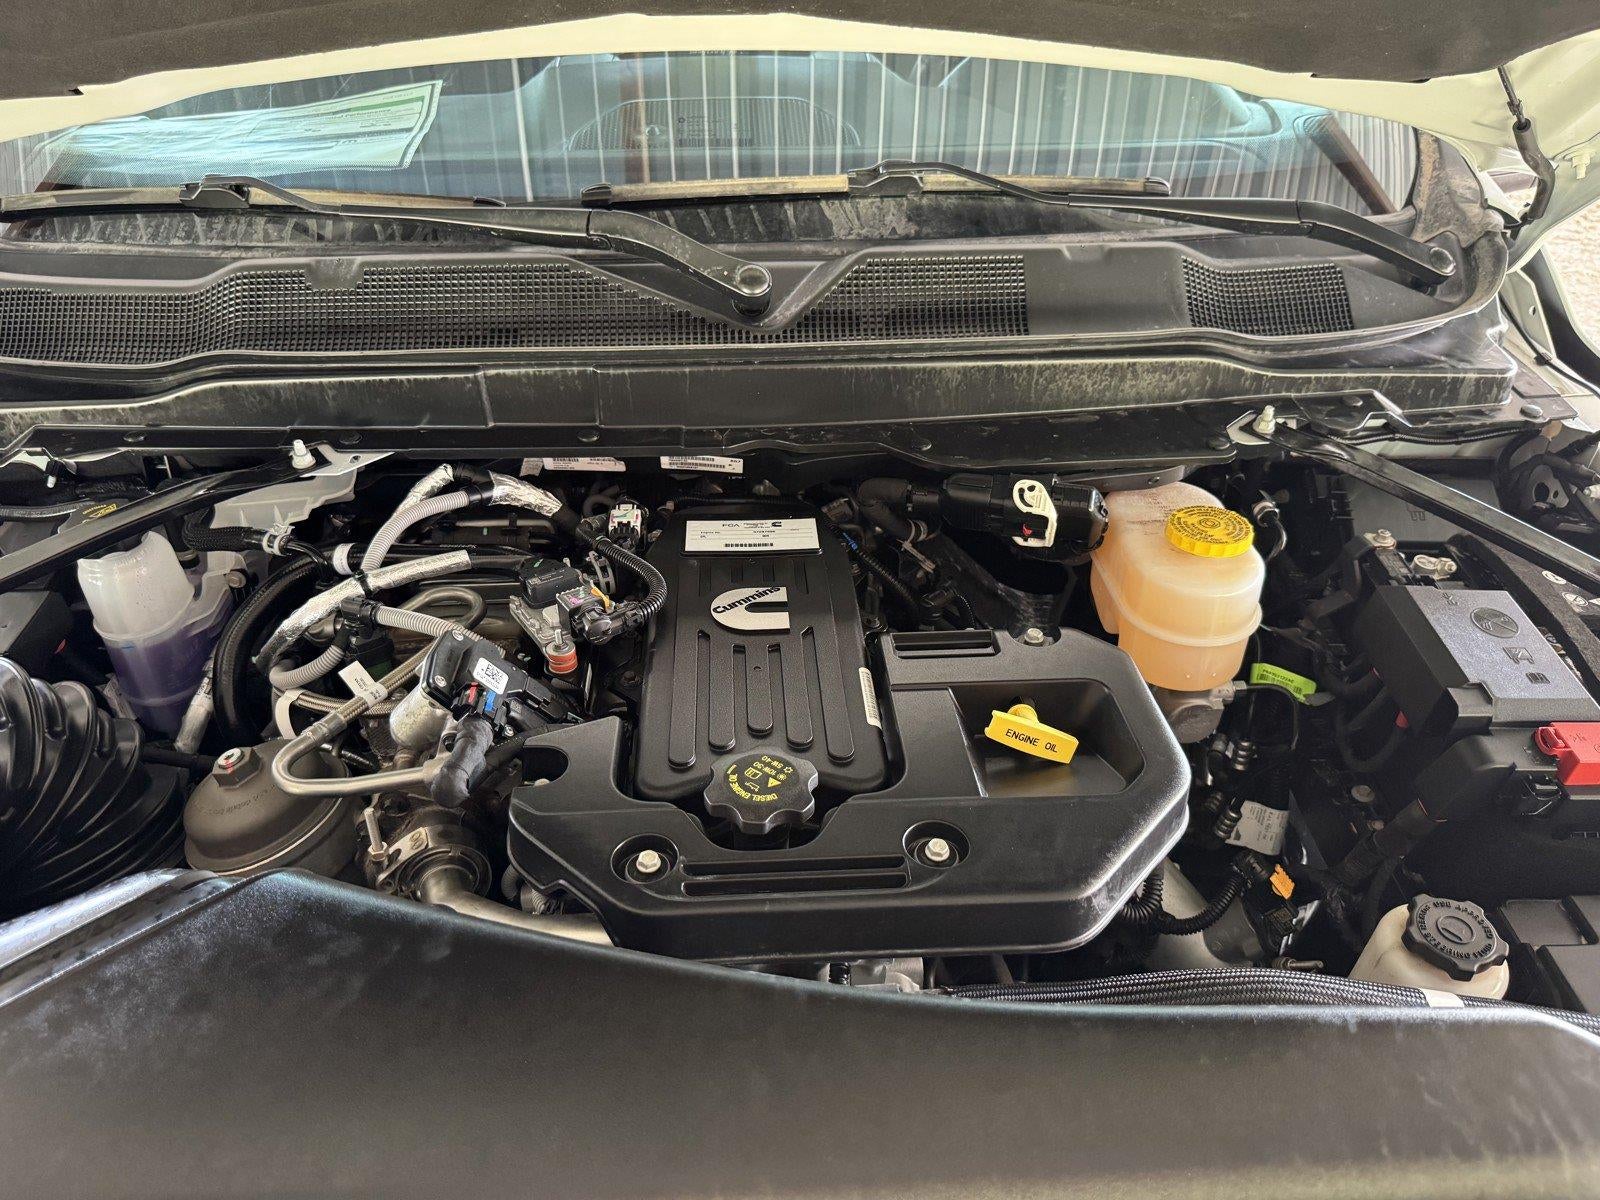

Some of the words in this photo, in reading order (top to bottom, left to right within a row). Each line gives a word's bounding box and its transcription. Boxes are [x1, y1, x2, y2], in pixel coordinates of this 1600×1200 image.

[712, 586, 781, 614] Cummins
[1005, 728, 1040, 747] ENGINE
[1044, 741, 1058, 753] OIL
[753, 761, 777, 776] 10W-30
[761, 755, 784, 769] 5W-40
[729, 782, 751, 800] ENGINE
[752, 792, 779, 802] DIESEL
